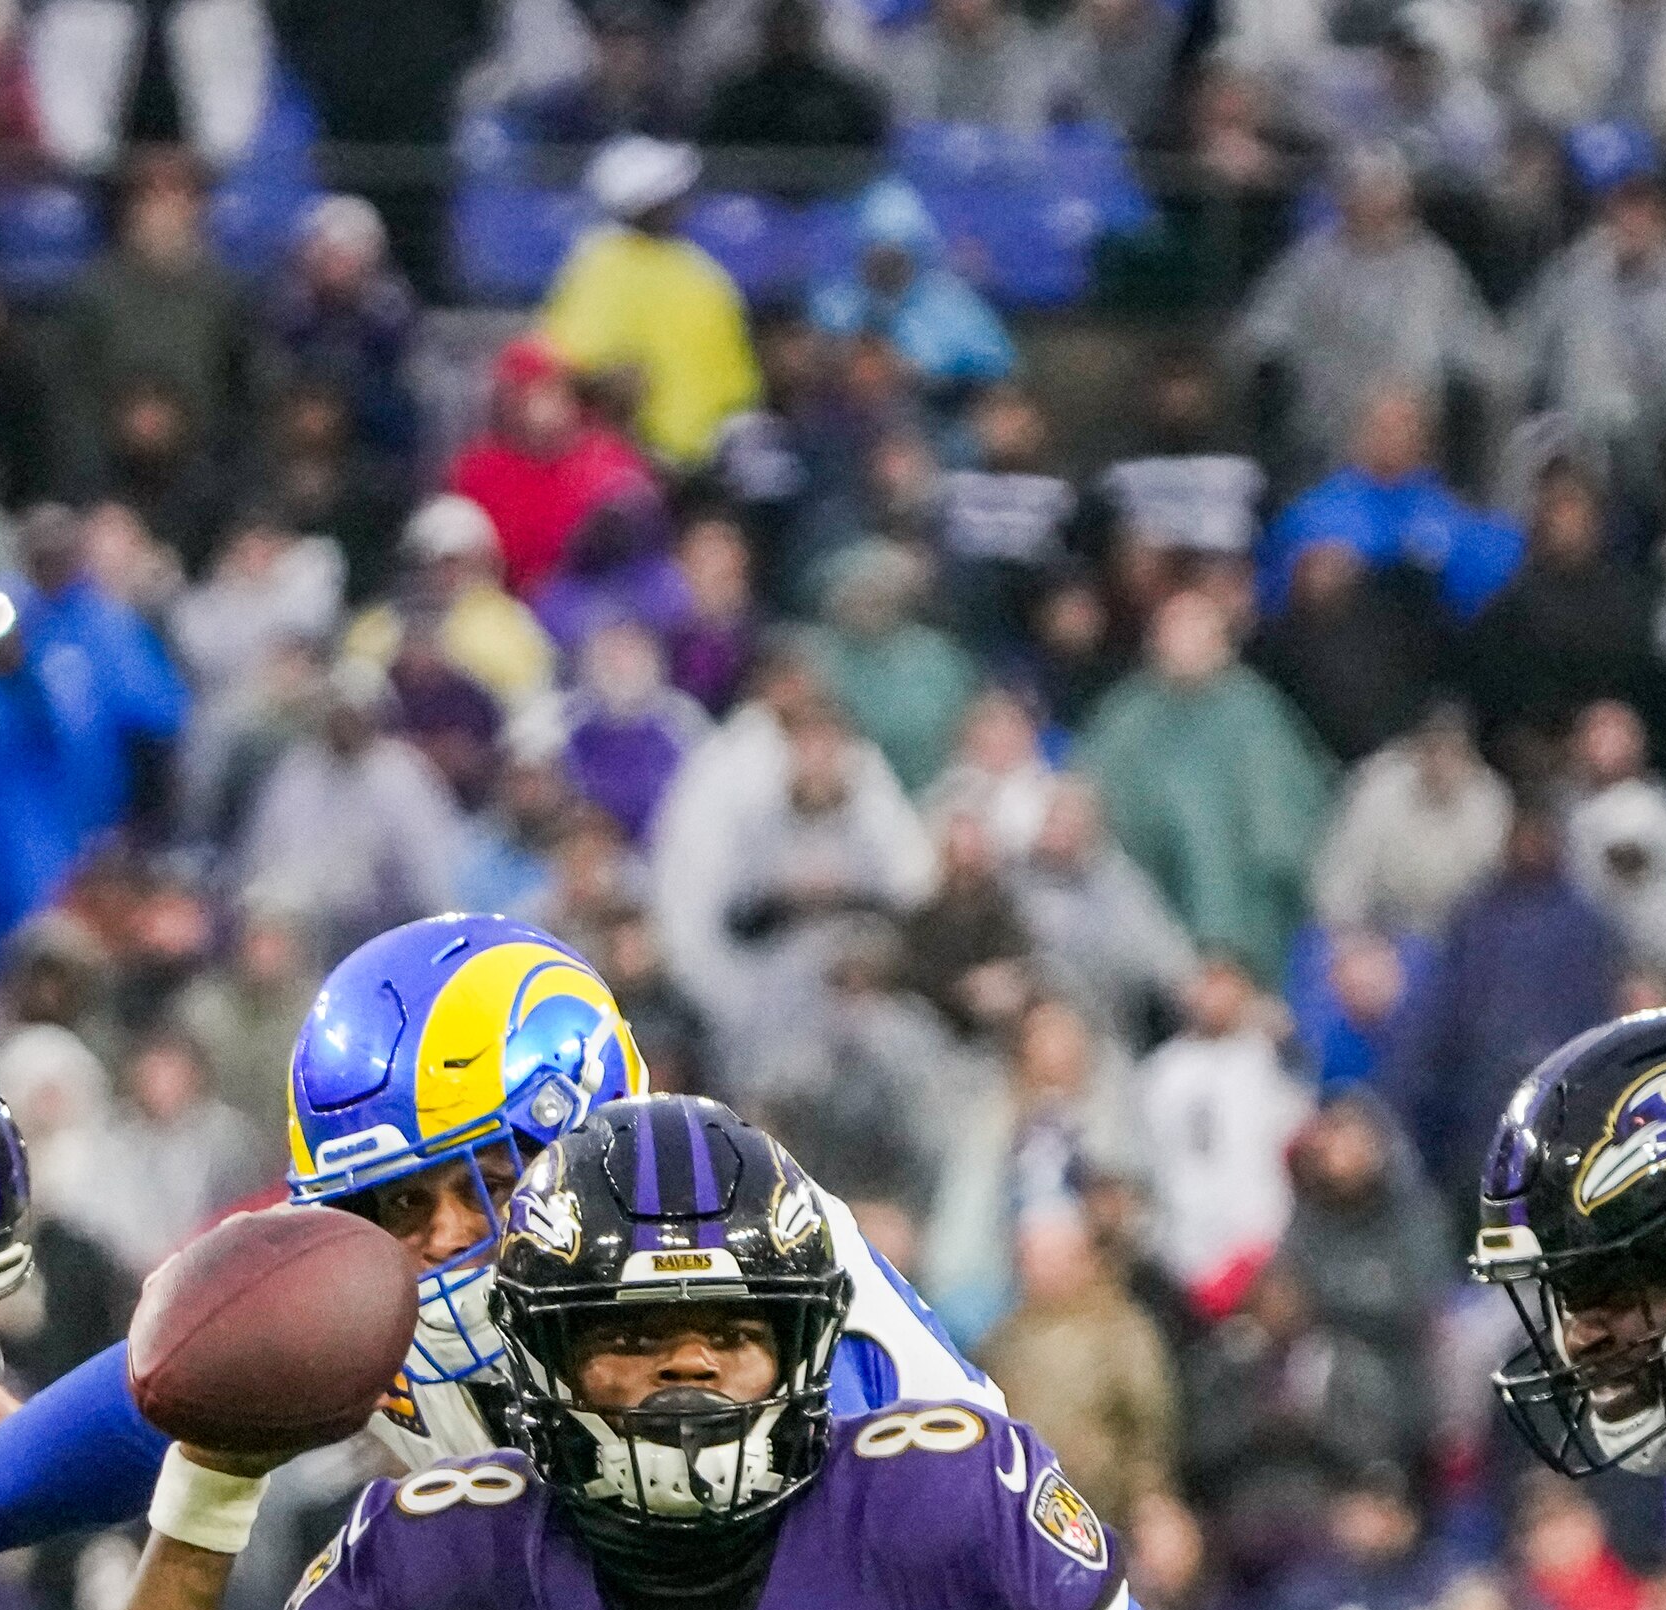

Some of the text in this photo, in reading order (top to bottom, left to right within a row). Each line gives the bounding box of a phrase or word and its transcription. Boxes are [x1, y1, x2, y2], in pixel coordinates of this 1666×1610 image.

[651, 1253, 712, 1272] RAVENS
[852, 1404, 986, 1459] 8
[395, 1464, 527, 1515] 8
